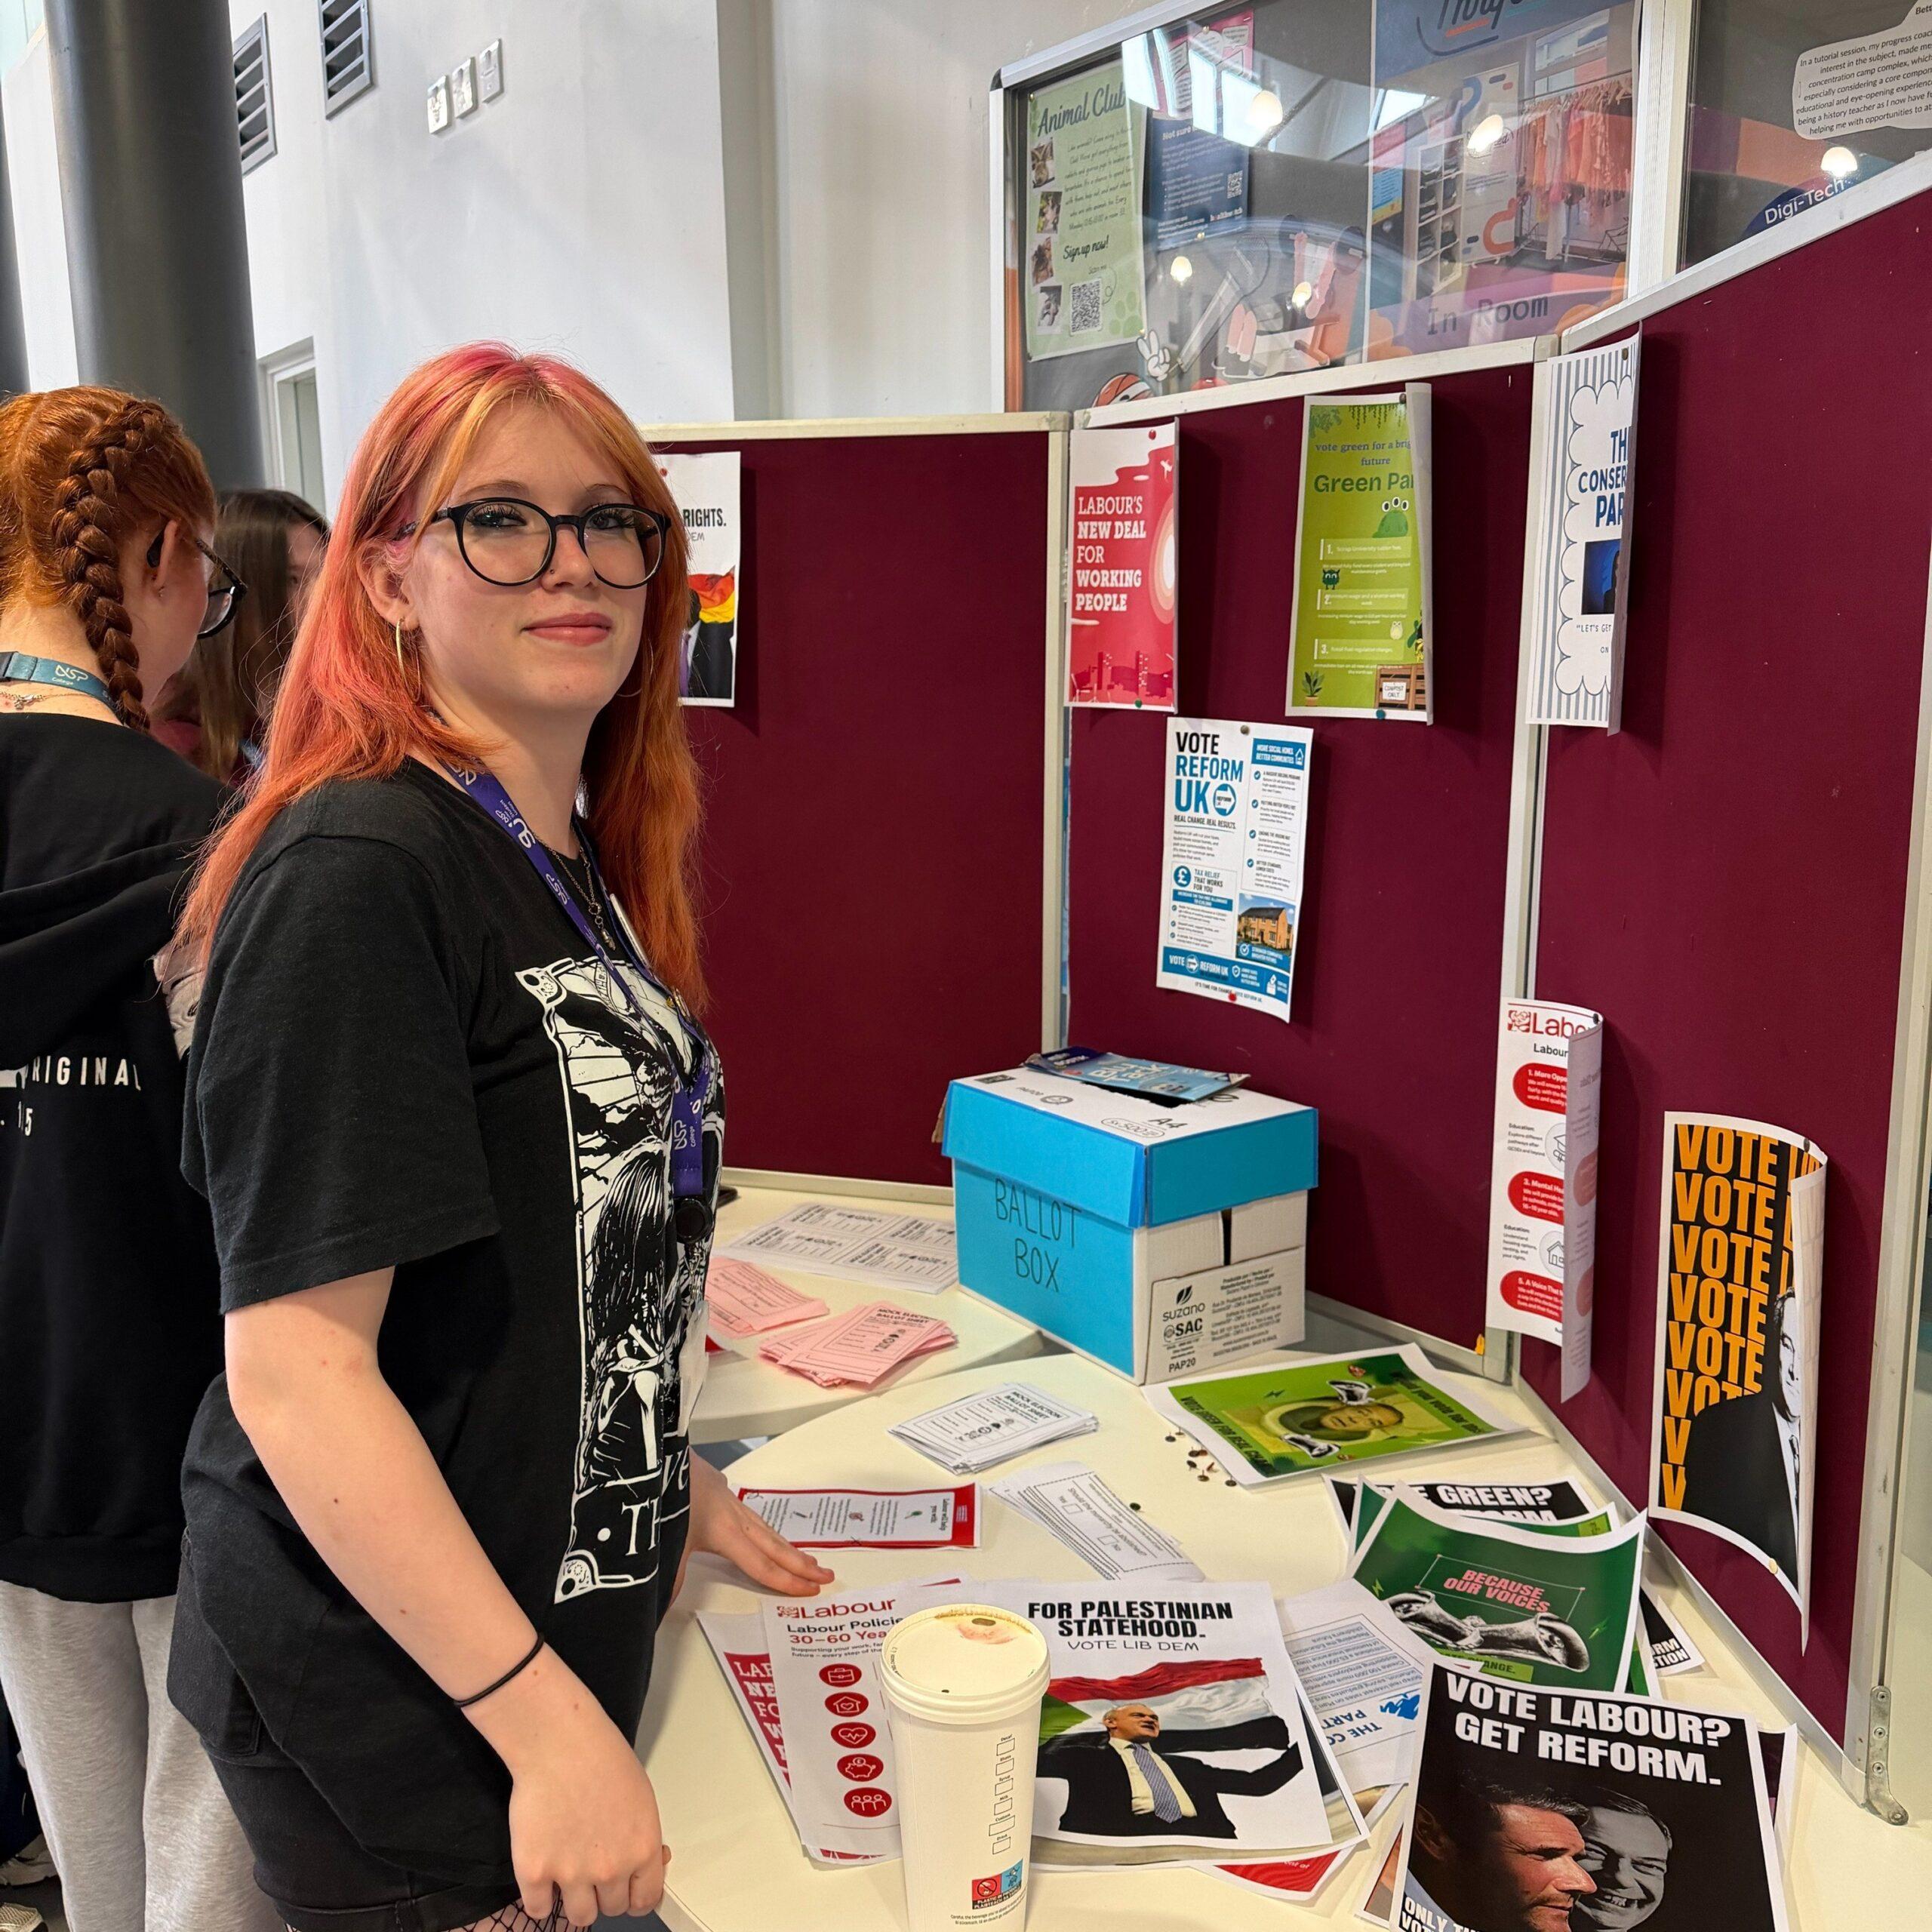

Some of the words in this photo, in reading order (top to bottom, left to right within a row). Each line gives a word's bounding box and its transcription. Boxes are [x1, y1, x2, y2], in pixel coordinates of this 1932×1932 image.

[1814, 52, 1839, 63] tutorial
[1840, 46, 1867, 57] session,
[1869, 42, 1879, 51] my
[1881, 35, 1912, 49] progress
[1820, 63, 1846, 74] interest
[1855, 57, 1867, 66] the
[1869, 52, 1897, 63] subject,
[1898, 45, 1918, 56] made
[1808, 71, 1855, 88] concentration
[1856, 67, 1875, 78] camp
[1877, 61, 1909, 73] complex,
[1804, 88, 1836, 101] especially
[1837, 78, 1877, 94] considering
[1884, 74, 1901, 84] core
[1038, 92, 1090, 137] Animal
[1093, 82, 1126, 116] Club
[1796, 101, 1835, 115] educational
[1835, 97, 1849, 106] and
[1850, 88, 1894, 103] eye-opening
[1798, 115, 1817, 125] being
[1823, 109, 1847, 120] history
[1849, 103, 1875, 115] teacher
[1890, 97, 1906, 106] now
[1907, 94, 1924, 103] have
[1810, 123, 1834, 135] helping
[1848, 117, 1863, 127] with
[1865, 107, 1912, 123] opportunities
[1764, 177, 1845, 226] Digi-Tech
[1426, 305, 1457, 337] In
[1477, 293, 1549, 326] Room
[1315, 441, 1337, 451] vote
[1340, 441, 1369, 453] green
[1372, 441, 1386, 451] for
[1611, 426, 1629, 463] TH
[1361, 457, 1391, 466] future
[1314, 474, 1382, 493] Green
[683, 508, 727, 527] RIGHTS.
[1078, 496, 1143, 515] LABOUR'S
[1077, 521, 1111, 540] NEW
[1114, 520, 1146, 539] DEAL
[1076, 546, 1104, 564] FOR
[1075, 569, 1142, 588] WORKING
[1075, 593, 1128, 611] PEOPLE
[1176, 731, 1220, 755] VOTE
[1175, 755, 1244, 783] REFORM
[1175, 779, 1211, 814] UK
[1169, 955, 1185, 966] VOTE
[1200, 961, 1221, 974] REFORM
[1532, 1012, 1590, 1040] Labo
[1534, 1043, 1569, 1057] Labour
[32, 1056, 141, 1091] RIGINAL
[1534, 1070, 1551, 1079] More
[1148, 1118, 1188, 1129] A4
[1677, 1124, 1778, 1186] VOTE
[995, 1177, 1081, 1248] BALLOT
[1674, 1171, 1775, 1241] VOTE
[1014, 1238, 1060, 1293] BOX
[1672, 1224, 1771, 1295] VOTE
[1163, 1303, 1205, 1321] suzano
[1670, 1273, 1768, 1346] VOTE
[1175, 1318, 1203, 1337] SAC
[1168, 1357, 1196, 1373] PAP20
[1668, 1321, 1764, 1394] VOTE
[1437, 1484, 1553, 1506] GREEN?
[1444, 1577, 1481, 1595] OUR
[1485, 1586, 1552, 1614] VOICES
[1463, 1570, 1544, 1600] BECAUSE
[800, 1598, 897, 1620] Labour
[1028, 1602, 1072, 1620] FOR
[1081, 1601, 1232, 1620] PALESTINIAN
[787, 1623, 845, 1634] Labour
[856, 1629, 891, 1641] Yea
[1058, 1619, 1206, 1638] STATEHOOD.
[1067, 1640, 1117, 1651] VOTE
[1123, 1640, 1152, 1651] LIB
[1158, 1641, 1199, 1651] DEM
[1653, 1648, 1689, 1667] TION
[1484, 1660, 1515, 1674] ANGE.
[1322, 1709, 1367, 1729] PART
[1446, 1672, 1539, 1720] VOTE
[1550, 1697, 1731, 1747] LABOUR?
[1348, 1721, 1383, 1738] THE
[1455, 1711, 1525, 1754] GET
[1537, 1729, 1721, 1786] REFORM.
[1404, 1896, 1448, 1932] ONLY
